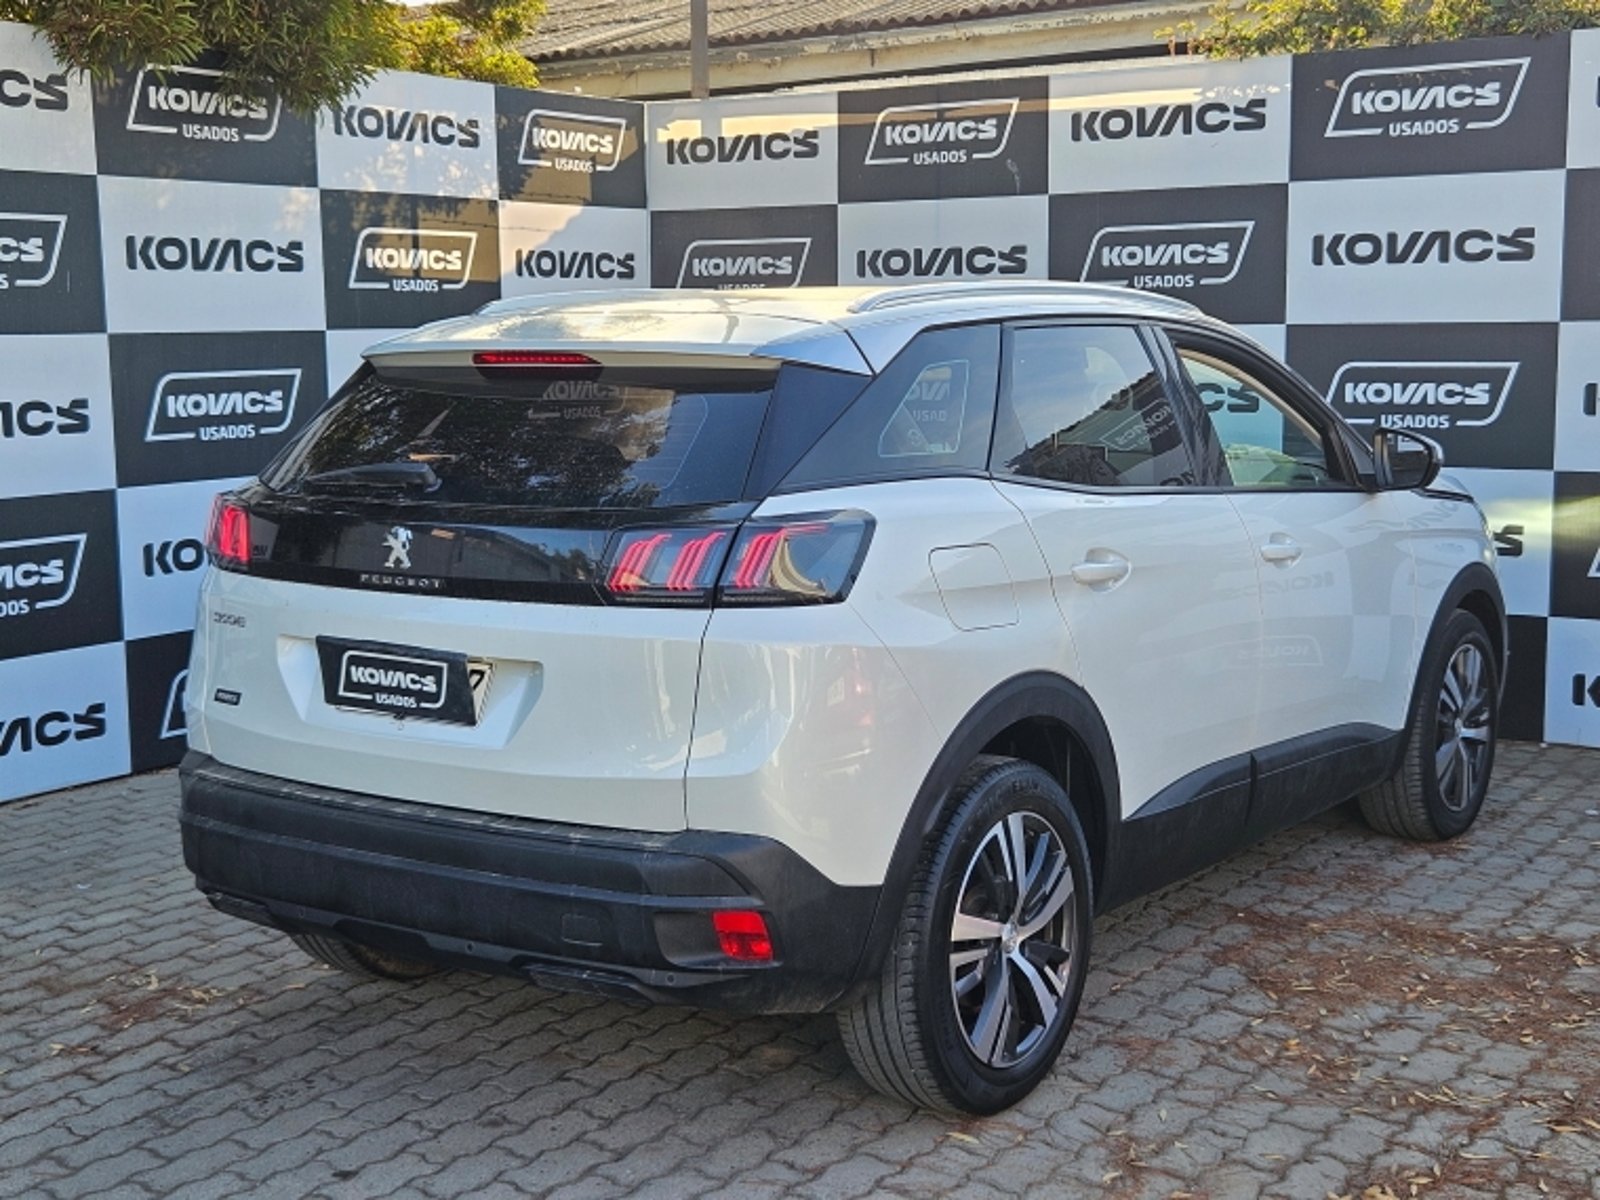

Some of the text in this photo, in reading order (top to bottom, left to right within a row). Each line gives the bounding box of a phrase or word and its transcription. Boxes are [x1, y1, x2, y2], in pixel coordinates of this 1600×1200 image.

[148, 85, 267, 120] KOVACS
[1352, 82, 1501, 115] KOVACS
[183, 123, 240, 142] USADOS
[332, 104, 480, 148] KOVACS
[885, 118, 997, 148] KOVACS
[1071, 98, 1267, 142] KOVACS
[1388, 118, 1460, 137] USADOS
[532, 127, 614, 154] KOVACS
[667, 130, 820, 165] KOVACS
[554, 157, 594, 174] USADOS
[912, 149, 968, 165] USADOS
[125, 235, 304, 273] KOVACS
[366, 247, 463, 272] KOVACS
[1102, 241, 1230, 267] KOVACS
[1312, 227, 1536, 266] KOVACS
[514, 247, 635, 280] KOVACS
[692, 255, 793, 276] KOVACS
[856, 244, 1028, 278] KOVACS
[392, 278, 439, 292] USADOS
[1133, 274, 1195, 289] USADOS
[167, 390, 283, 418] KOVACS
[1344, 382, 1491, 406] KOVACS
[199, 425, 256, 441] USADOS
[1380, 414, 1450, 429] USADOS
[1493, 525, 1524, 557] S
[143, 538, 213, 577] KO
[360, 573, 440, 588] PEUGEOT
[350, 664, 437, 693] KOVACS
[374, 692, 418, 709] USADOS
[0, 703, 106, 757] ACS
